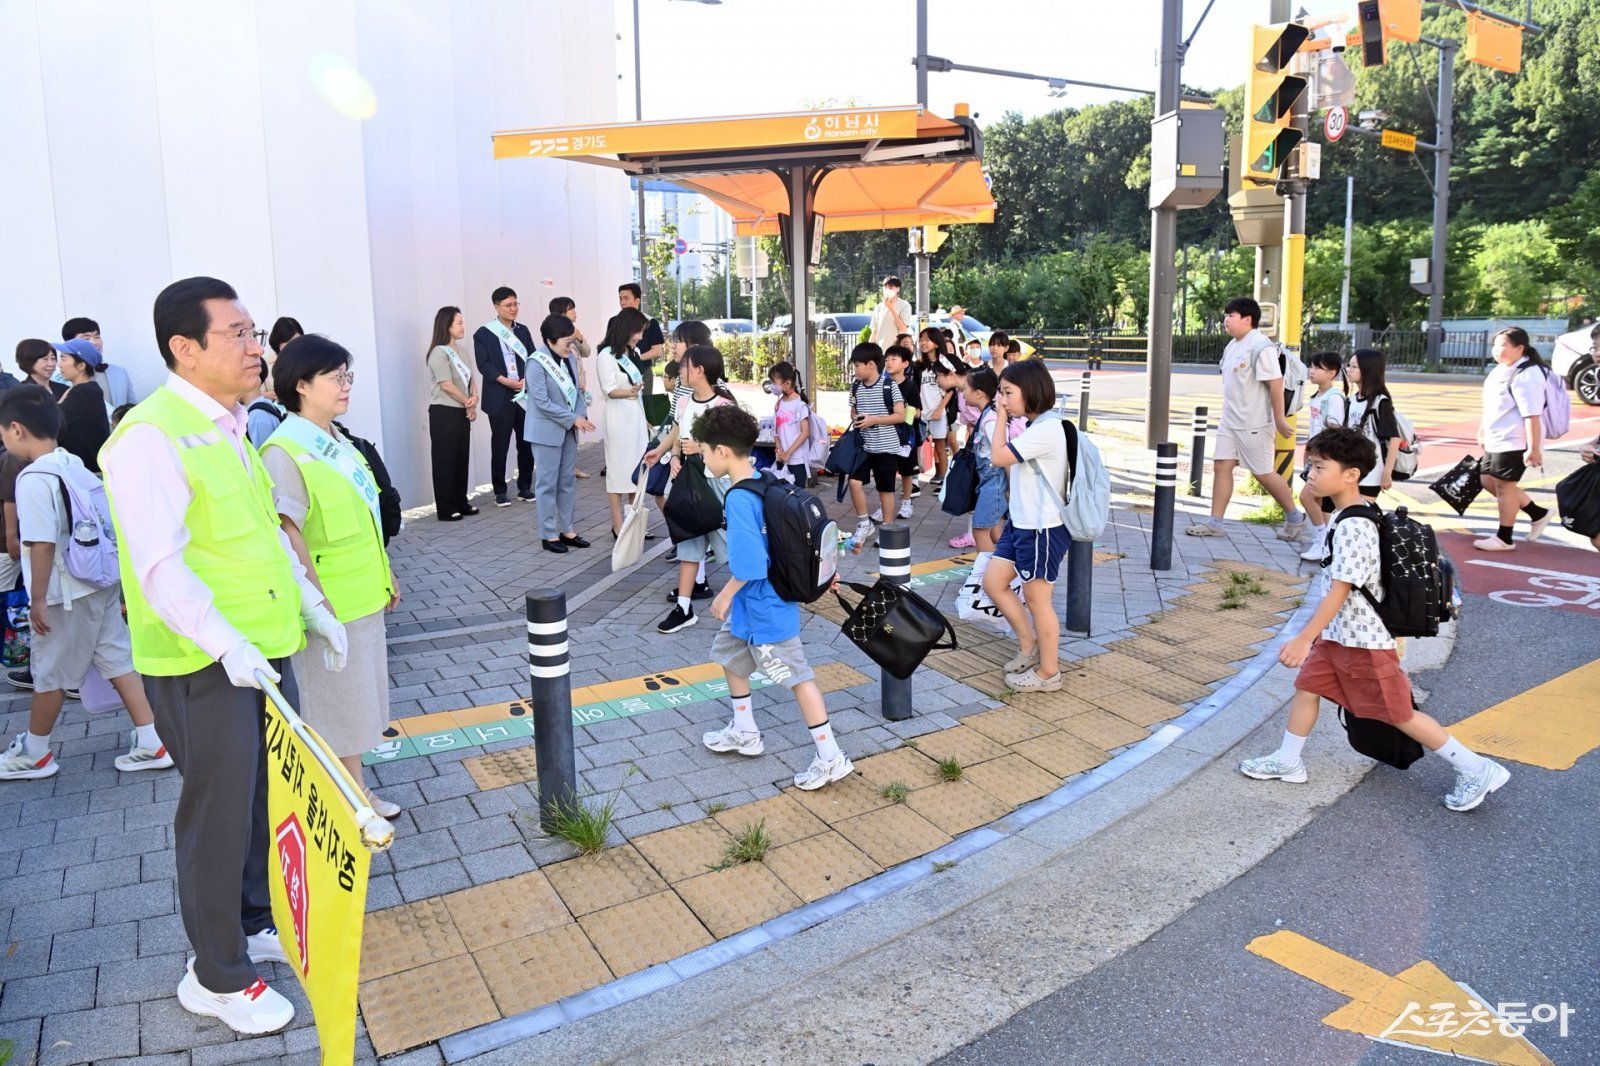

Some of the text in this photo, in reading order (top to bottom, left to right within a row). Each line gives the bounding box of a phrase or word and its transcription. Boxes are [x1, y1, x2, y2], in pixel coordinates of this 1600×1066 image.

[824, 113, 879, 130] 하남시
[1329, 113, 1343, 130] 30
[824, 127, 879, 138] Hanam city
[572, 135, 607, 151] 경기도
[763, 657, 792, 684] STAR
